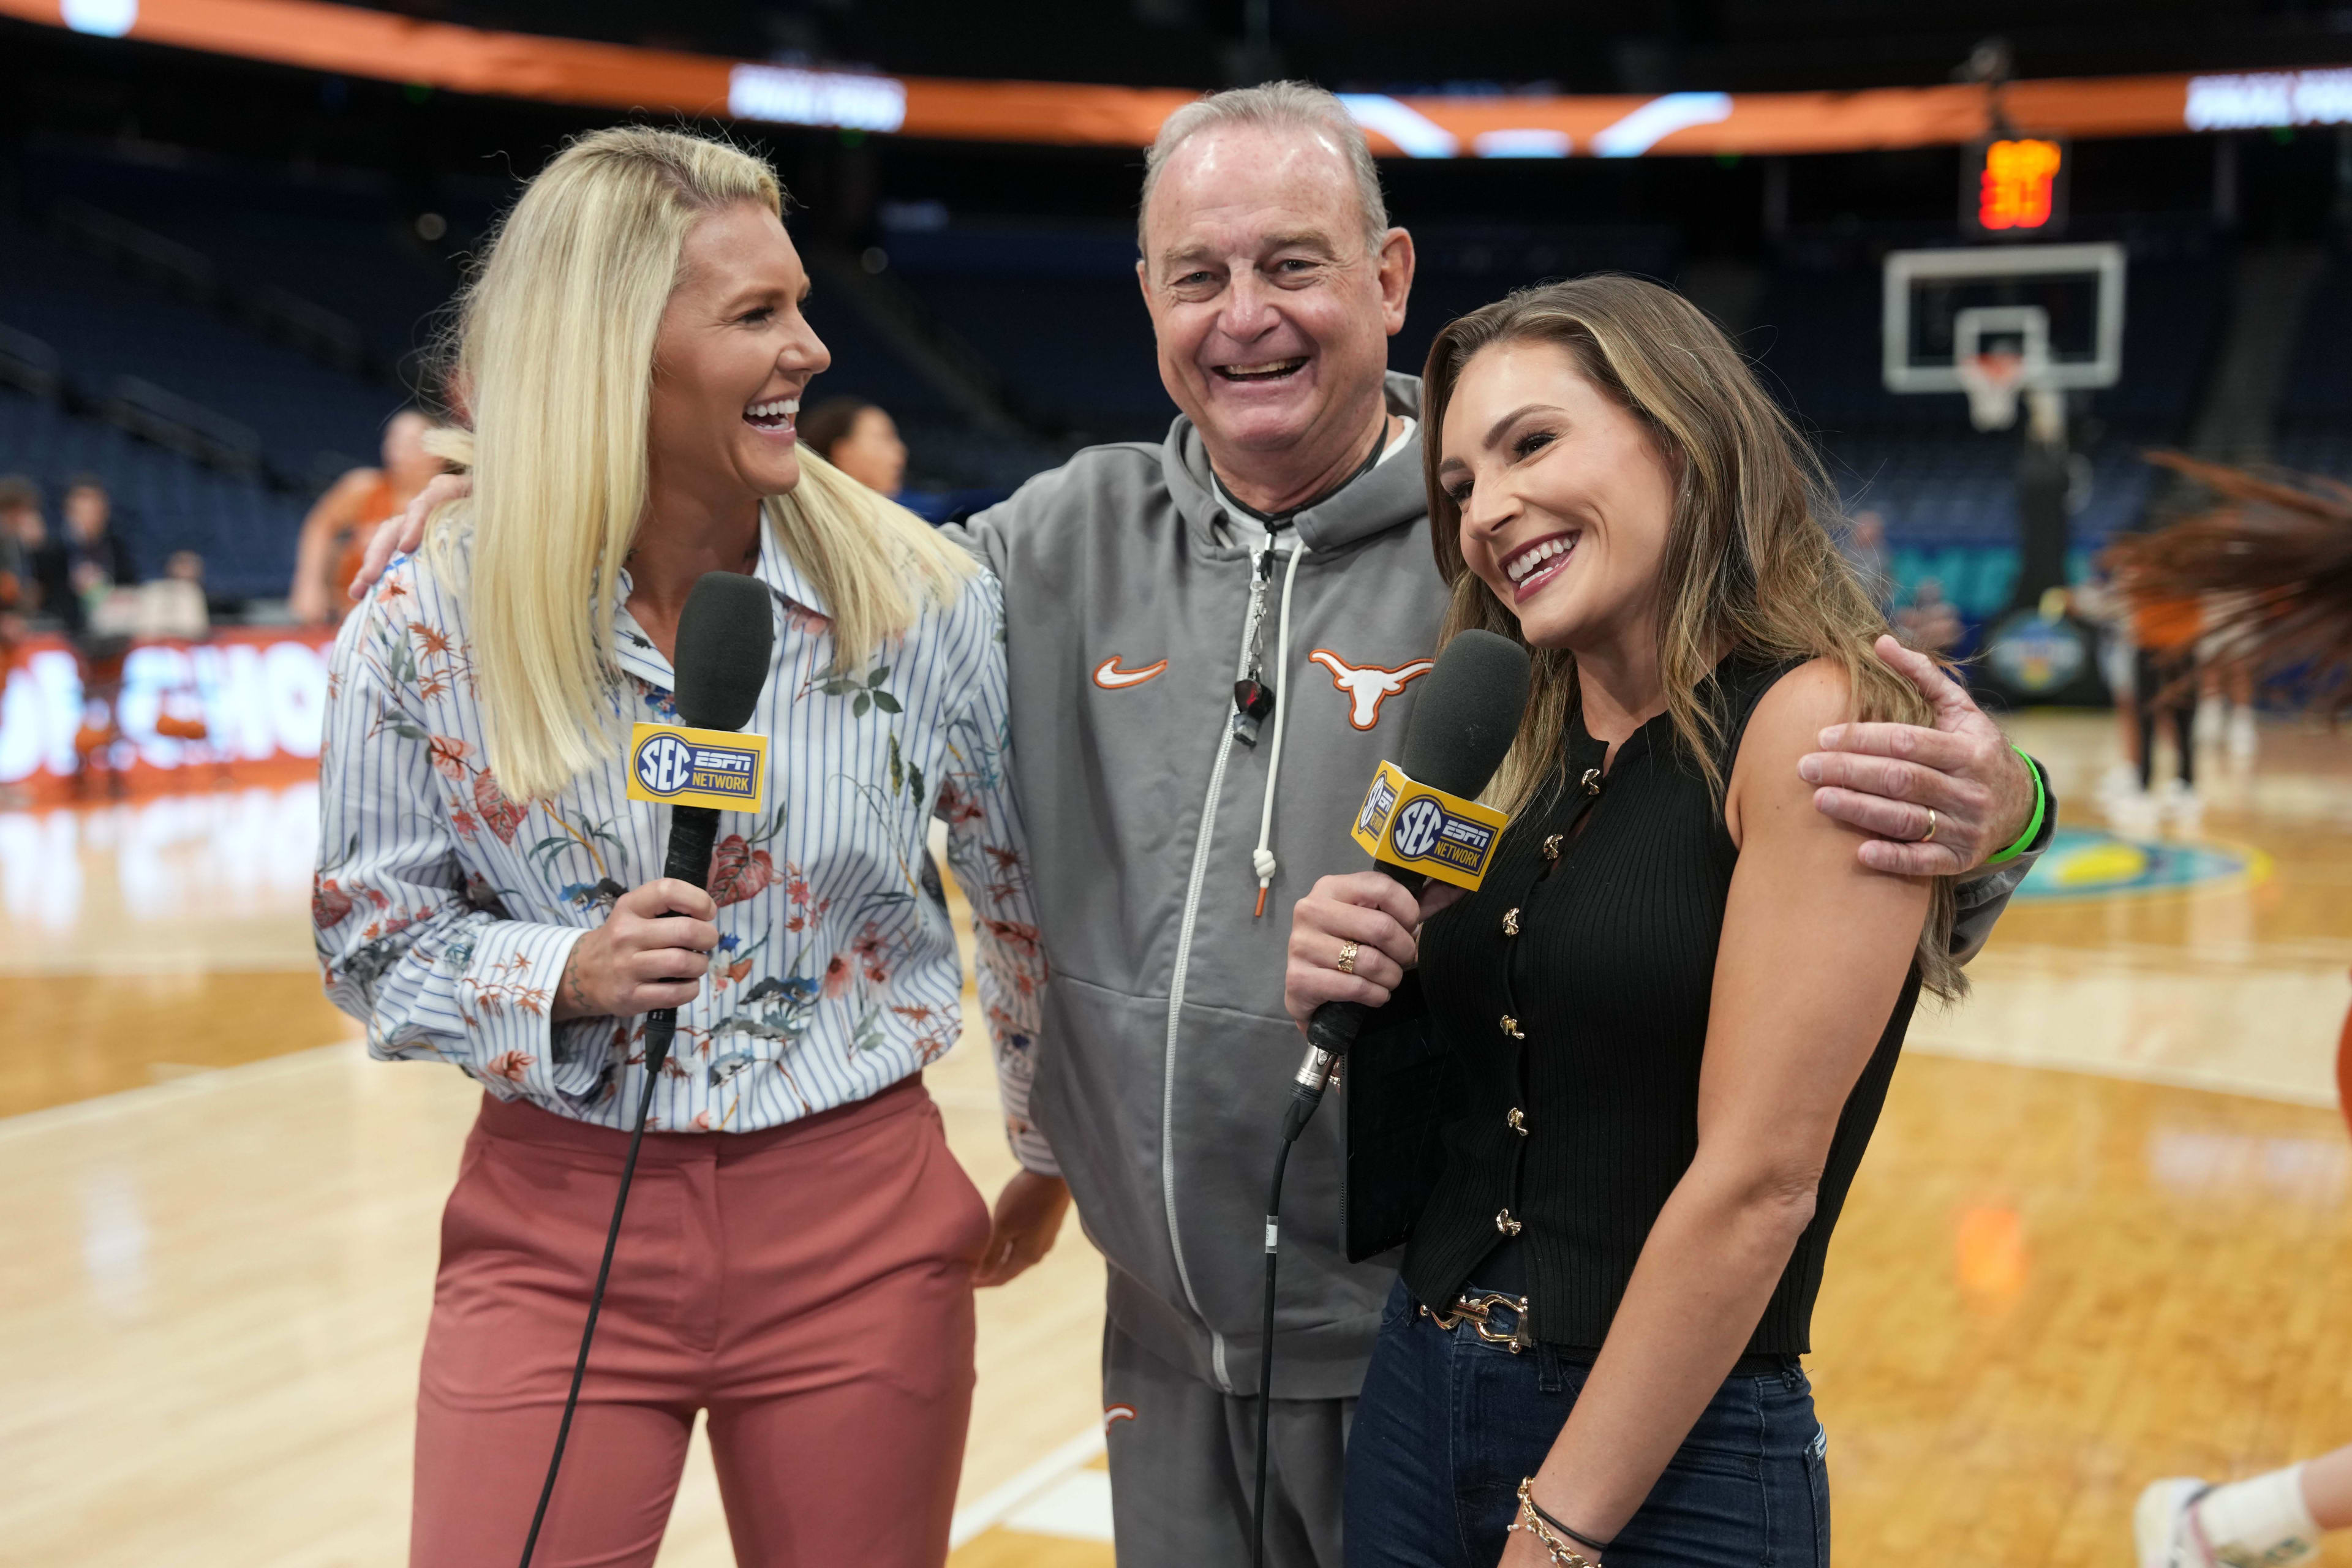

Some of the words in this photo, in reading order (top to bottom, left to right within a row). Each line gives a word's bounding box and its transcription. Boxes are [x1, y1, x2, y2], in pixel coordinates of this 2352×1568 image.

[641, 738, 691, 791] SEC
[694, 751, 752, 771] ESPN
[692, 772, 749, 791] NETWORK
[1360, 776, 1384, 828] SEC
[1395, 801, 1441, 855] SEC
[1442, 820, 1490, 848] ESPN
[1434, 840, 1480, 868] NETWORK
